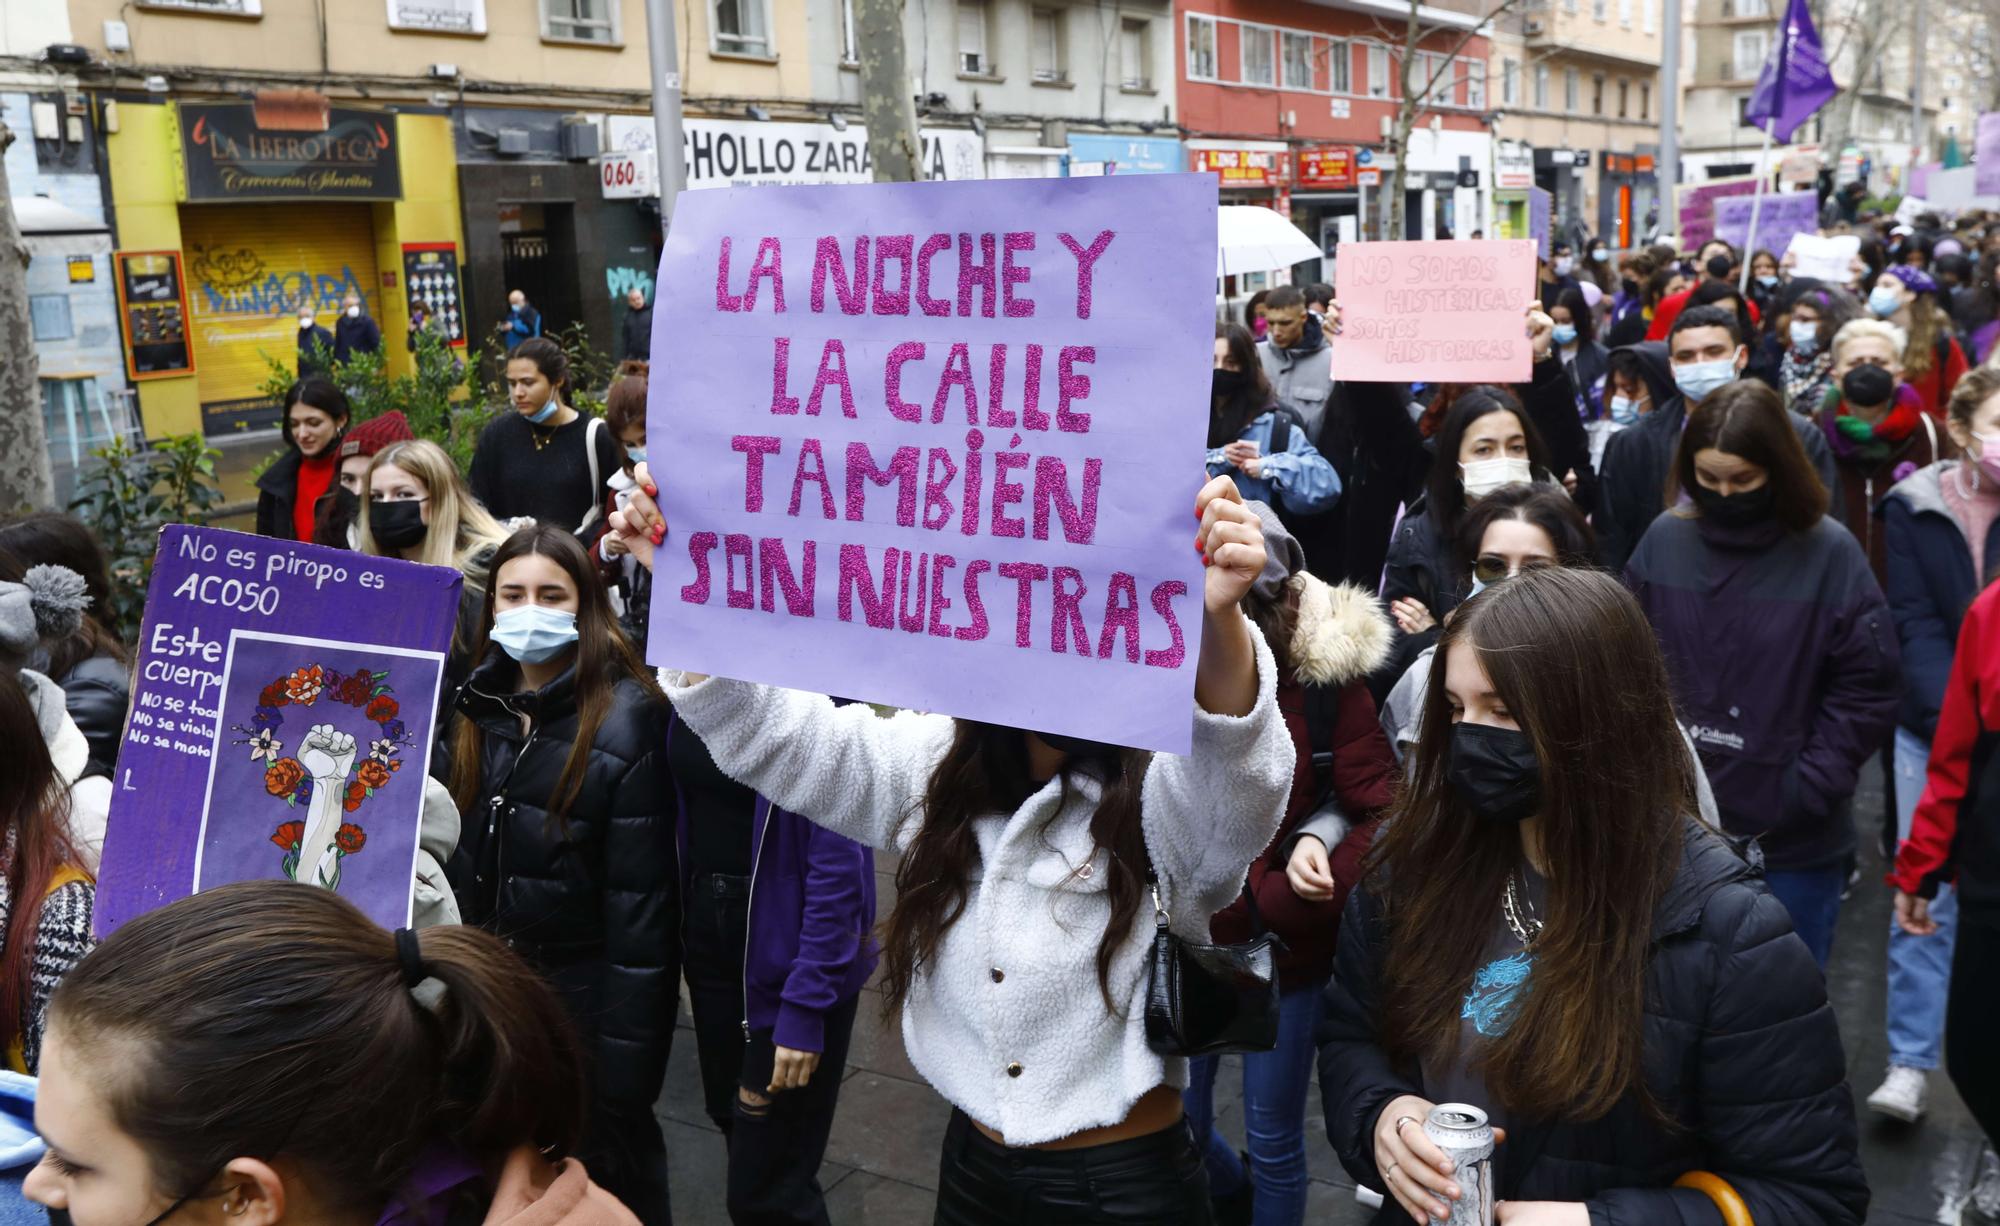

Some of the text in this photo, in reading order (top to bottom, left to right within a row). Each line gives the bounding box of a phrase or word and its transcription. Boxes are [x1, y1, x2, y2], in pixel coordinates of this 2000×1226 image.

[210, 131, 378, 161] LA IBEROTECA
[804, 137, 947, 181] ZARAA
[604, 161, 635, 188] 0,60
[716, 229, 1117, 319] LA NOCHE Y
[1352, 255, 1499, 287] NO SOMOS
[1384, 284, 1522, 314] HISTÉRICAS
[1351, 317, 1421, 340] SOMOS
[770, 337, 1097, 434] LA CALLE
[731, 427, 1103, 545] TAMBIÉN
[179, 534, 385, 590] No es piropo es
[173, 574, 280, 616] ACOSO
[681, 531, 1188, 670] SON NUESTRAS
[151, 623, 222, 663] Este
[163, 697, 185, 713] se
[188, 699, 218, 719] toca
[153, 735, 170, 748] se
[157, 717, 175, 731] se
[180, 718, 215, 739] viola
[123, 768, 137, 790] L
